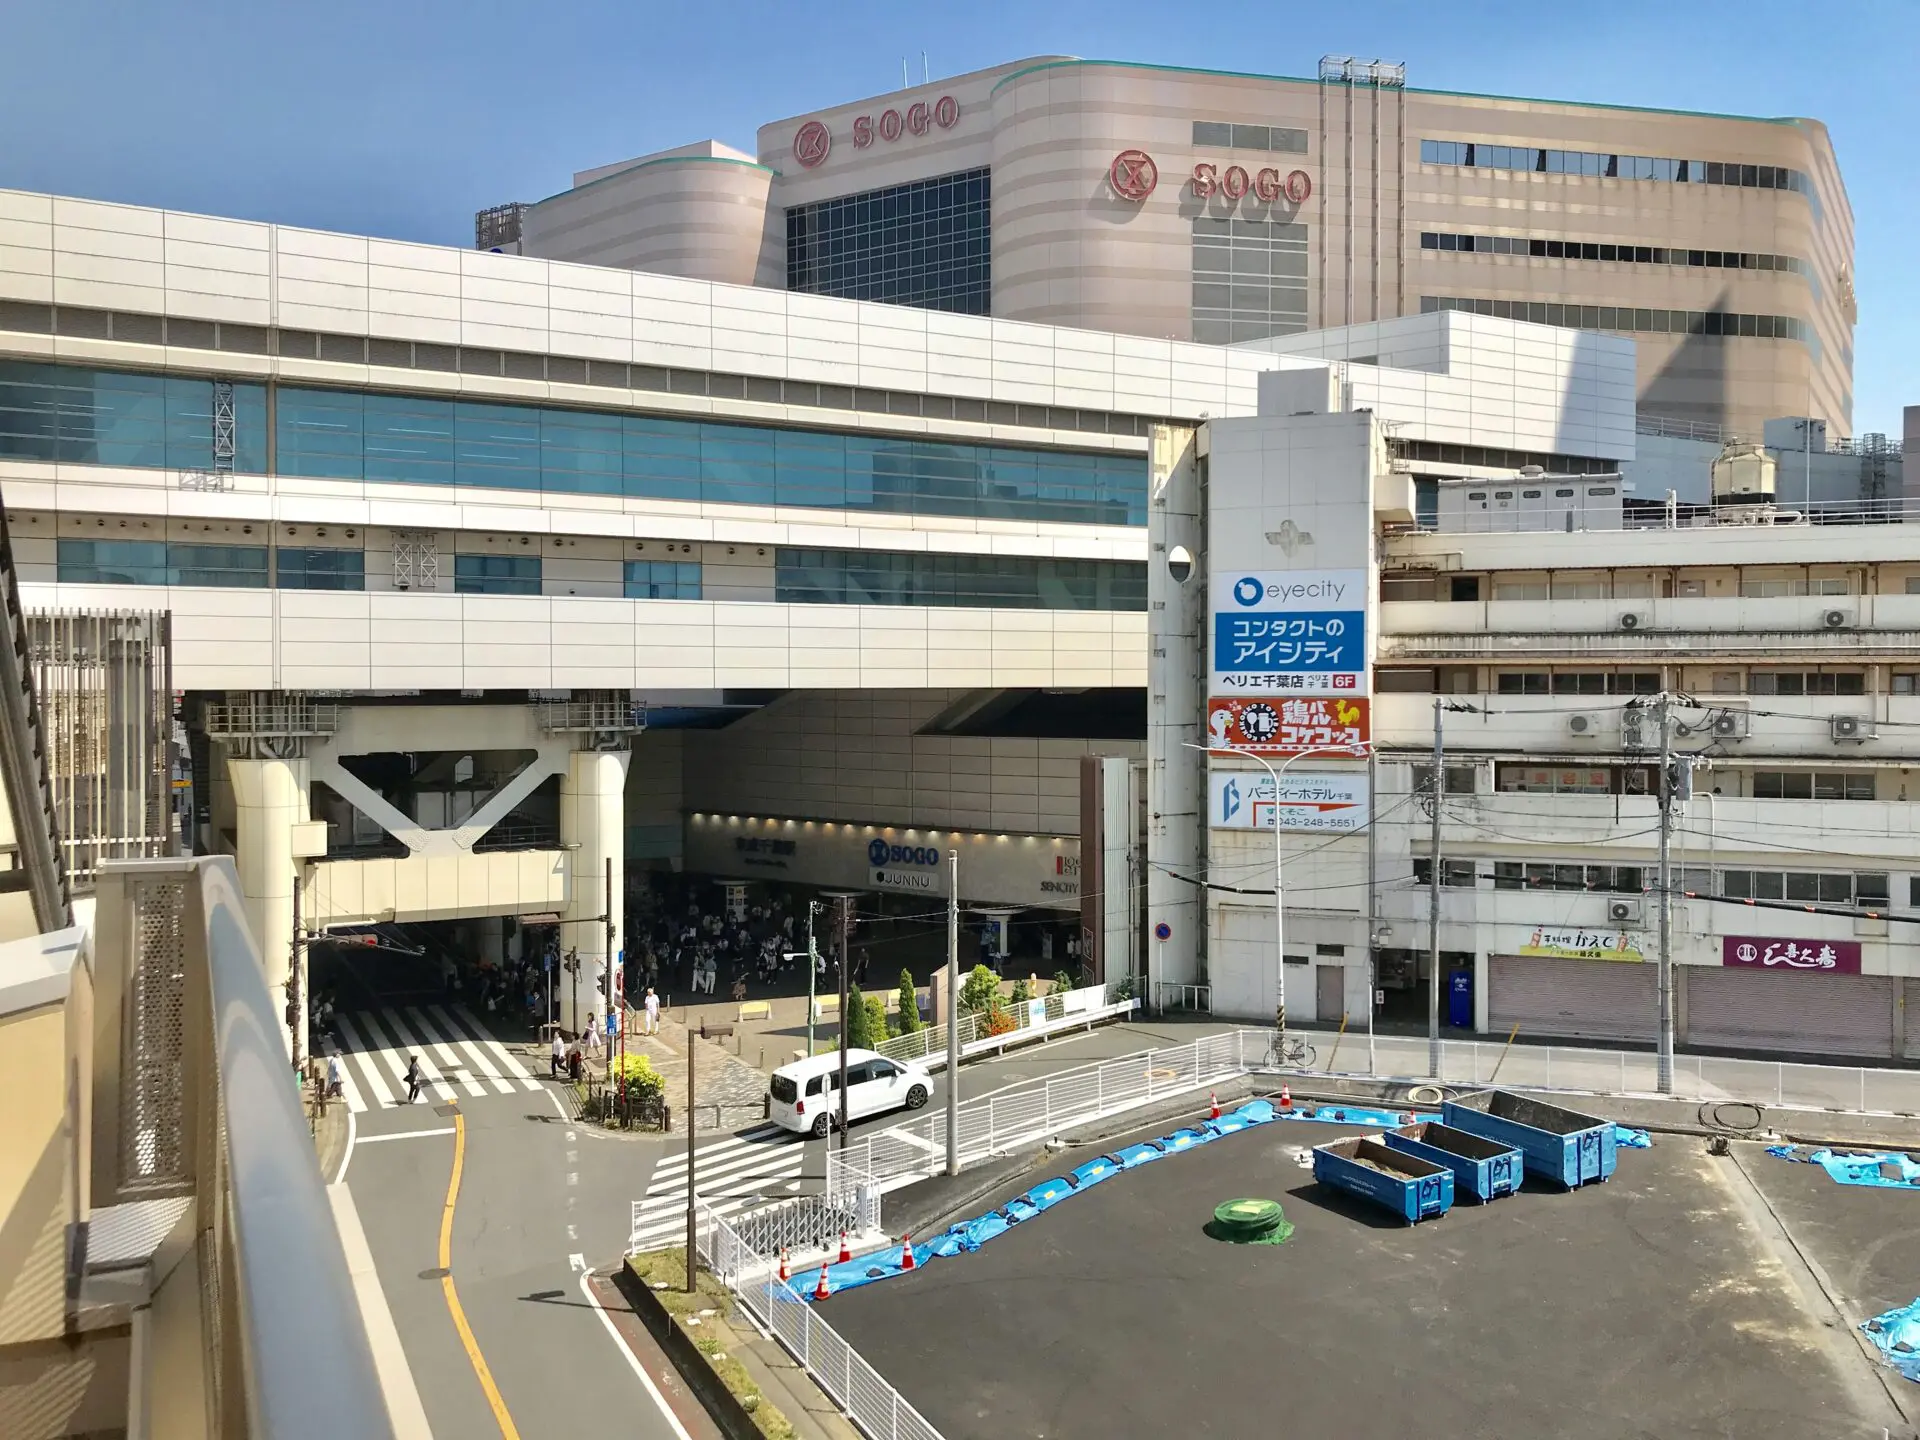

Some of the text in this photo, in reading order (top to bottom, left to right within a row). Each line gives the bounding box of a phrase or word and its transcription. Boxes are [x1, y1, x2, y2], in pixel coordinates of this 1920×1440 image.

[853, 95, 959, 149] SOGO
[1192, 163, 1312, 203] SOGO
[1266, 580, 1345, 603] eyecity
[1233, 618, 1345, 637] コンタクトの
[1233, 641, 1345, 664] アイシティ
[1335, 675, 1354, 687] 6F
[1281, 726, 1360, 744] コケコッコ
[890, 845, 939, 866] SOGO
[885, 873, 930, 888] JUNNU
[1040, 881, 1079, 894] SENCITY
[1575, 933, 1614, 948] かえで
